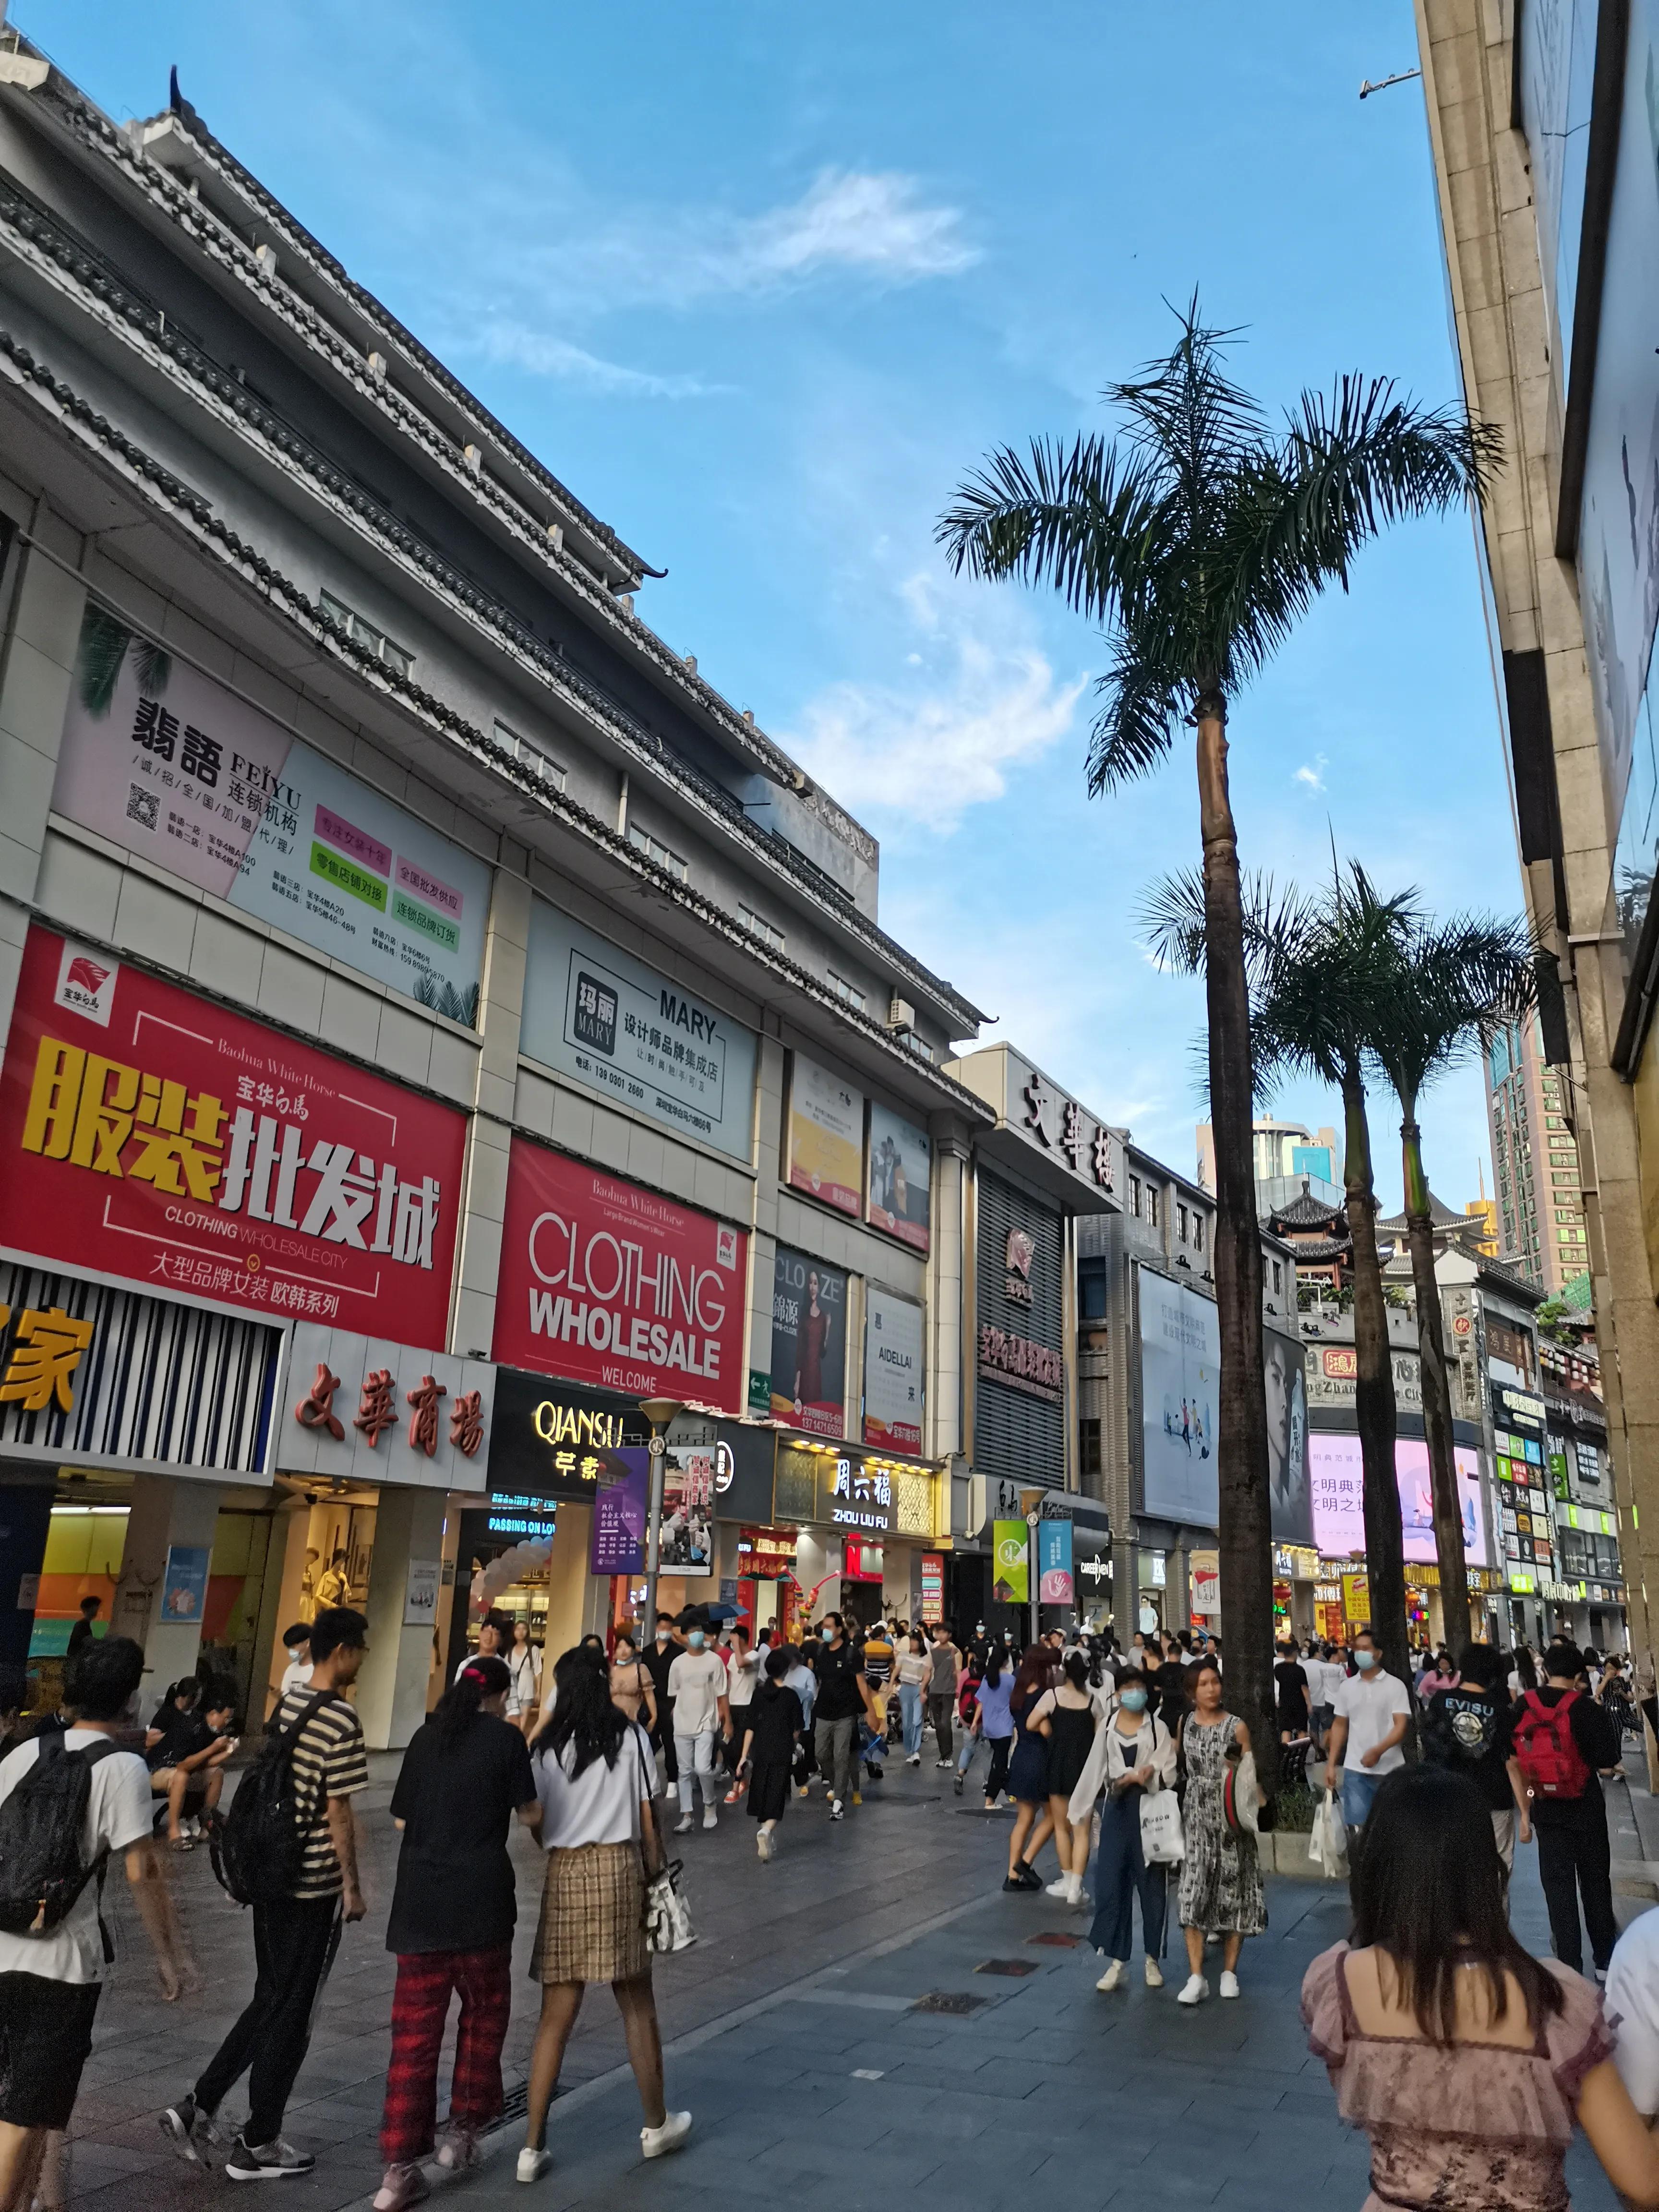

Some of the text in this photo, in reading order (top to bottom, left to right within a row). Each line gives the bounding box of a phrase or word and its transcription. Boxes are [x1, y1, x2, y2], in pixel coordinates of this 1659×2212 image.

[229, 752, 301, 810] FEIYU
[227, 779, 298, 836] 连锁机构
[322, 817, 385, 865] 专注女装十年
[317, 852, 382, 903] 零售店铺对接
[400, 866, 458, 911] 全国批发供应
[397, 900, 455, 945] 连锁品牌订货
[579, 981, 616, 1026] 玛丽
[660, 989, 717, 1045] MARY
[577, 1012, 613, 1046] MARY
[624, 1012, 719, 1082] 设计师品牌集成店
[218, 1038, 336, 1097] Baohua White Horse
[593, 1179, 684, 1226] Baohua White Horse
[165, 1206, 348, 1269] CLOTHING WHOLESALE CITY
[149, 1251, 340, 1319] 大型品牌女装 欧韩系列
[529, 1212, 725, 1333] CLOTHING
[529, 1286, 721, 1380] WHOLESALE
[0, 1302, 95, 1414] 家
[601, 1365, 657, 1393] WELCOME
[534, 1401, 624, 1449] QIANSU
[555, 1451, 600, 1480] 芊素
[833, 1459, 891, 1508] 周六福
[489, 1517, 527, 1532] PASSING
[528, 1521, 541, 1534] ON
[833, 1508, 889, 1529] ZHOU LIU FU
[1445, 1698, 1494, 1717] EVISU
